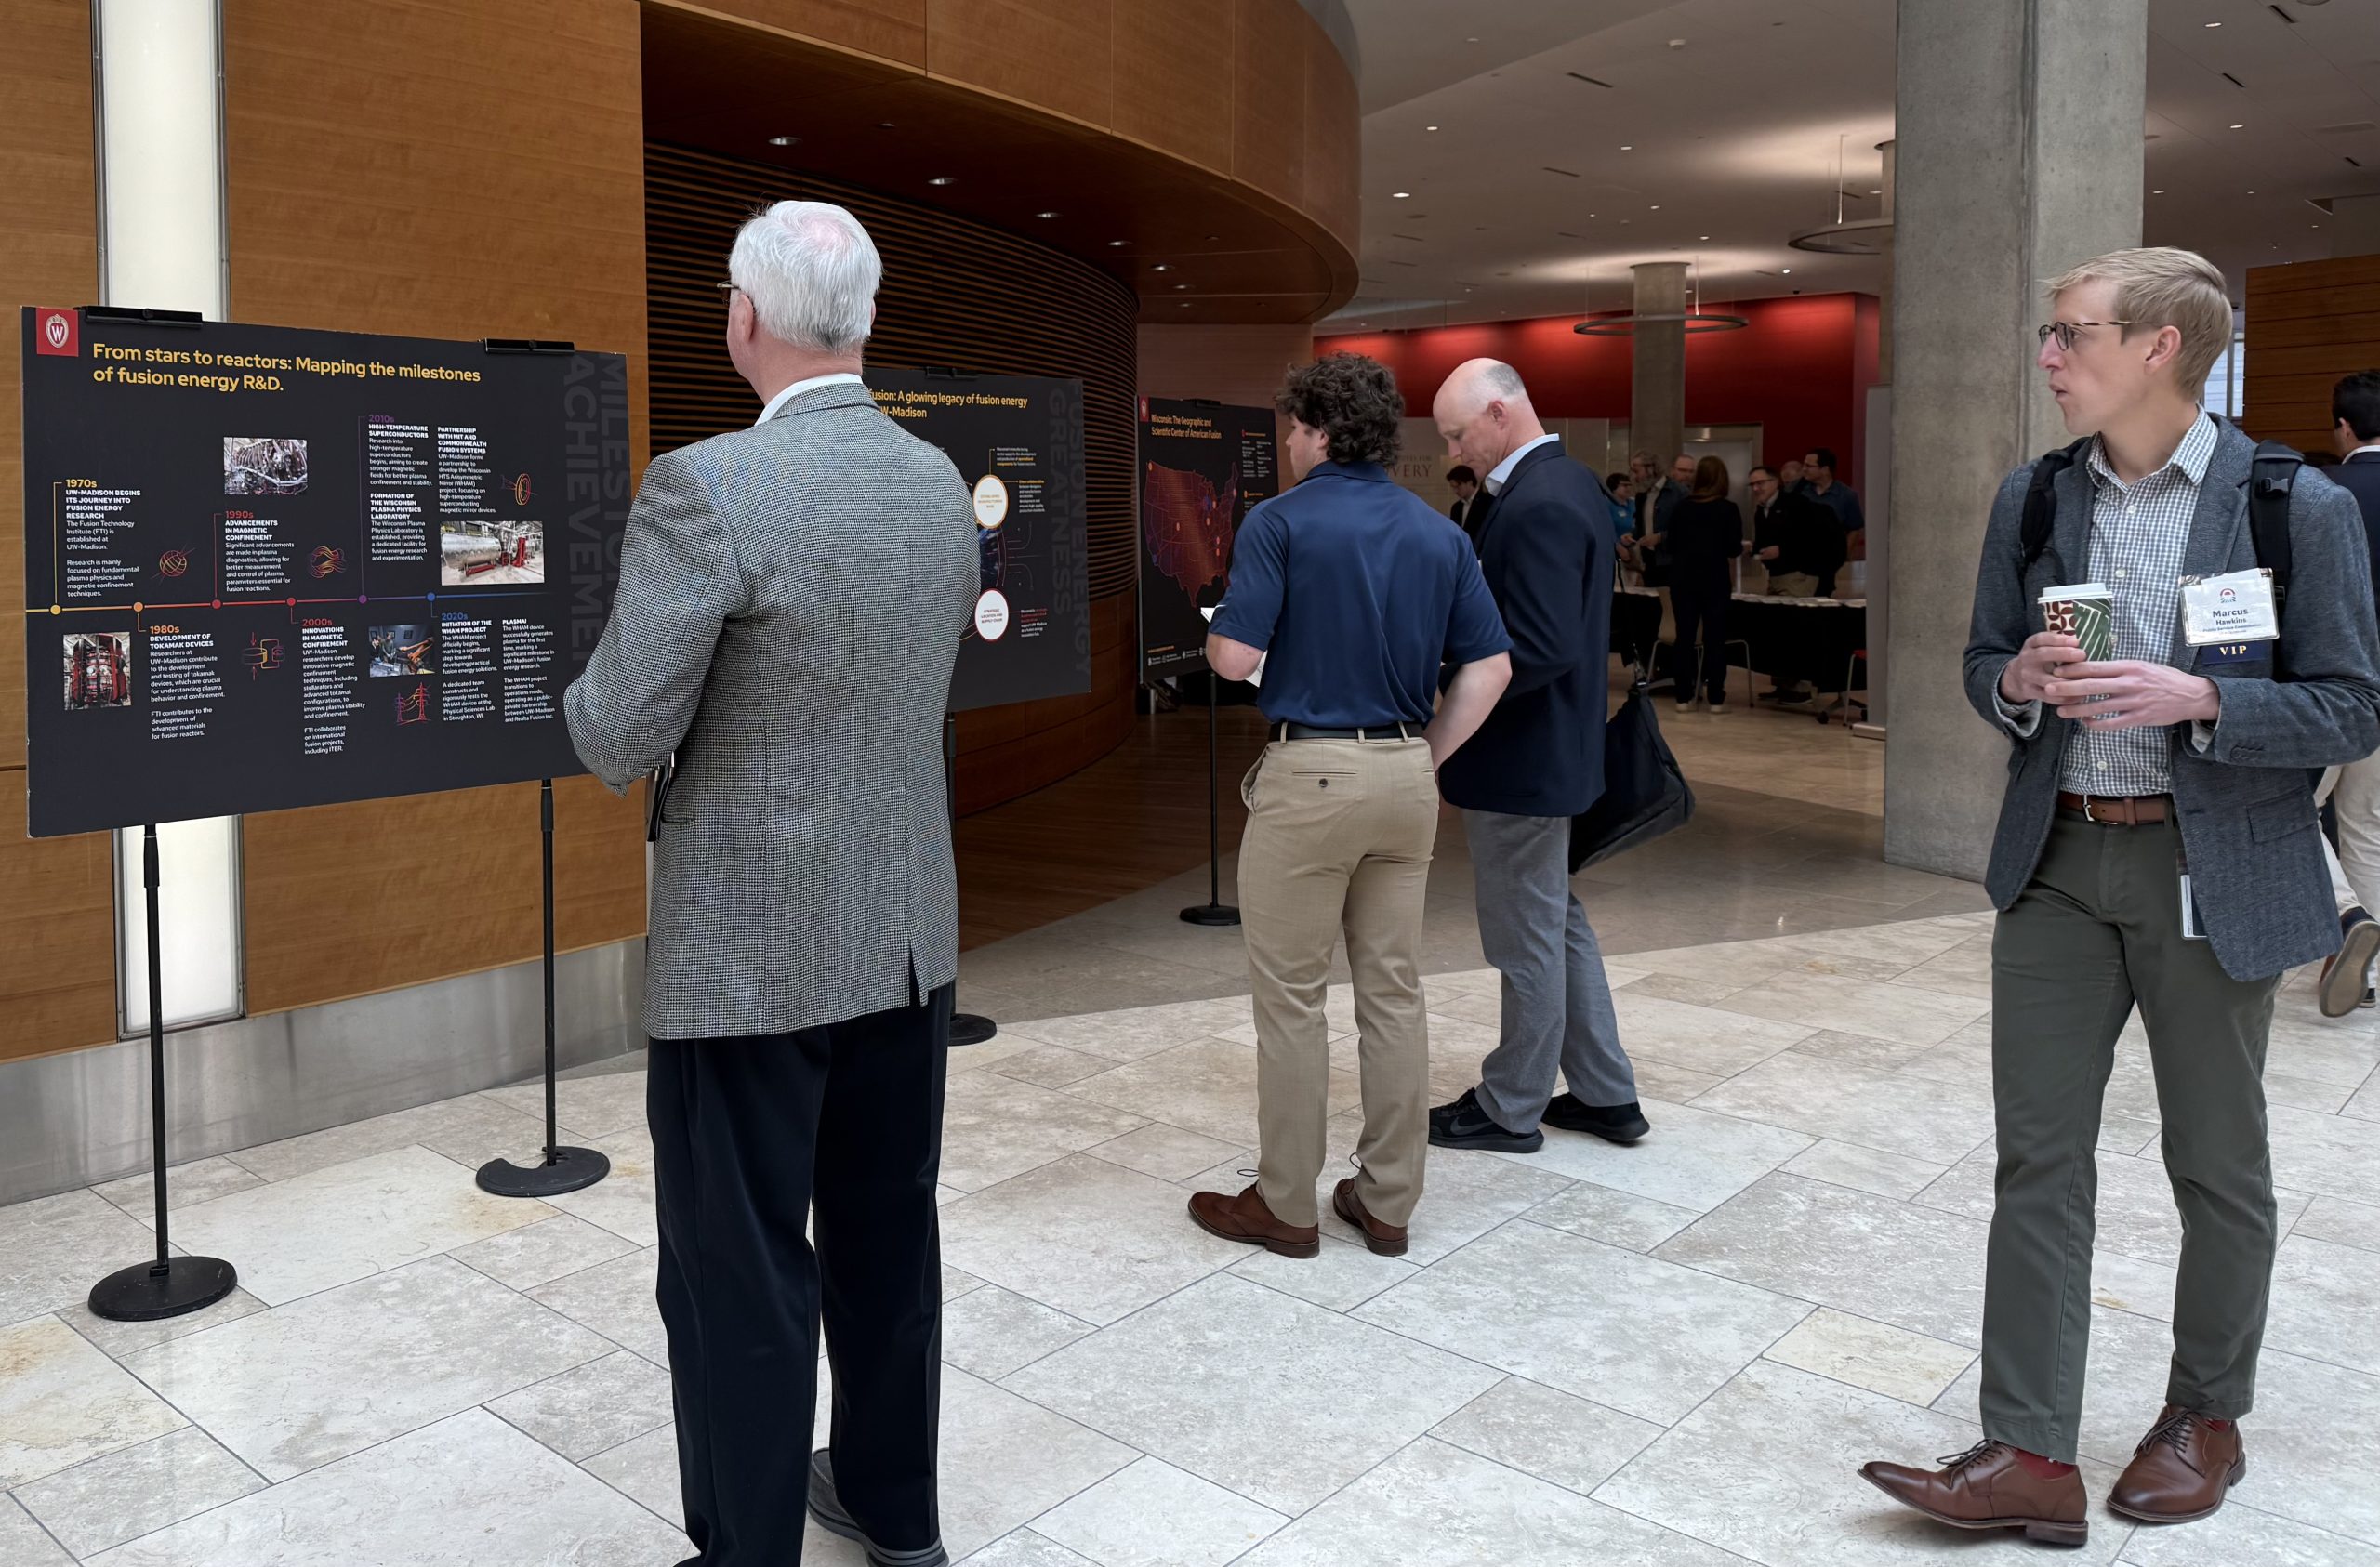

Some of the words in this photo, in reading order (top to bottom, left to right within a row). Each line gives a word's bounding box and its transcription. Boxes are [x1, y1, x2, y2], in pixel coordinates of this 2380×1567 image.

[51, 325, 63, 341] W
[93, 344, 141, 361] From
[145, 348, 190, 363] stars
[193, 350, 212, 365] to
[217, 354, 291, 370] reactors:
[296, 356, 365, 378] Mapping
[369, 361, 395, 376] the
[399, 363, 481, 381] milestones
[93, 368, 113, 382] of
[118, 369, 174, 385] fusion
[178, 375, 240, 392] energy
[244, 375, 284, 390] R&D.
[898, 391, 905, 402] A
[906, 391, 937, 404] glowing
[939, 392, 964, 405] legacy
[966, 393, 974, 403] of
[976, 394, 999, 404] fusion
[1001, 398, 1028, 408] energy
[880, 405, 927, 417] W-Madison
[1392, 464, 1432, 477] VERY
[66, 479, 97, 487] 1970s
[1049, 388, 1072, 615] GREATNESS
[564, 356, 603, 662] ACHIEVEME
[2213, 608, 2248, 617] Marcus
[150, 625, 179, 634] 1980s
[2220, 645, 2246, 655] VIP
